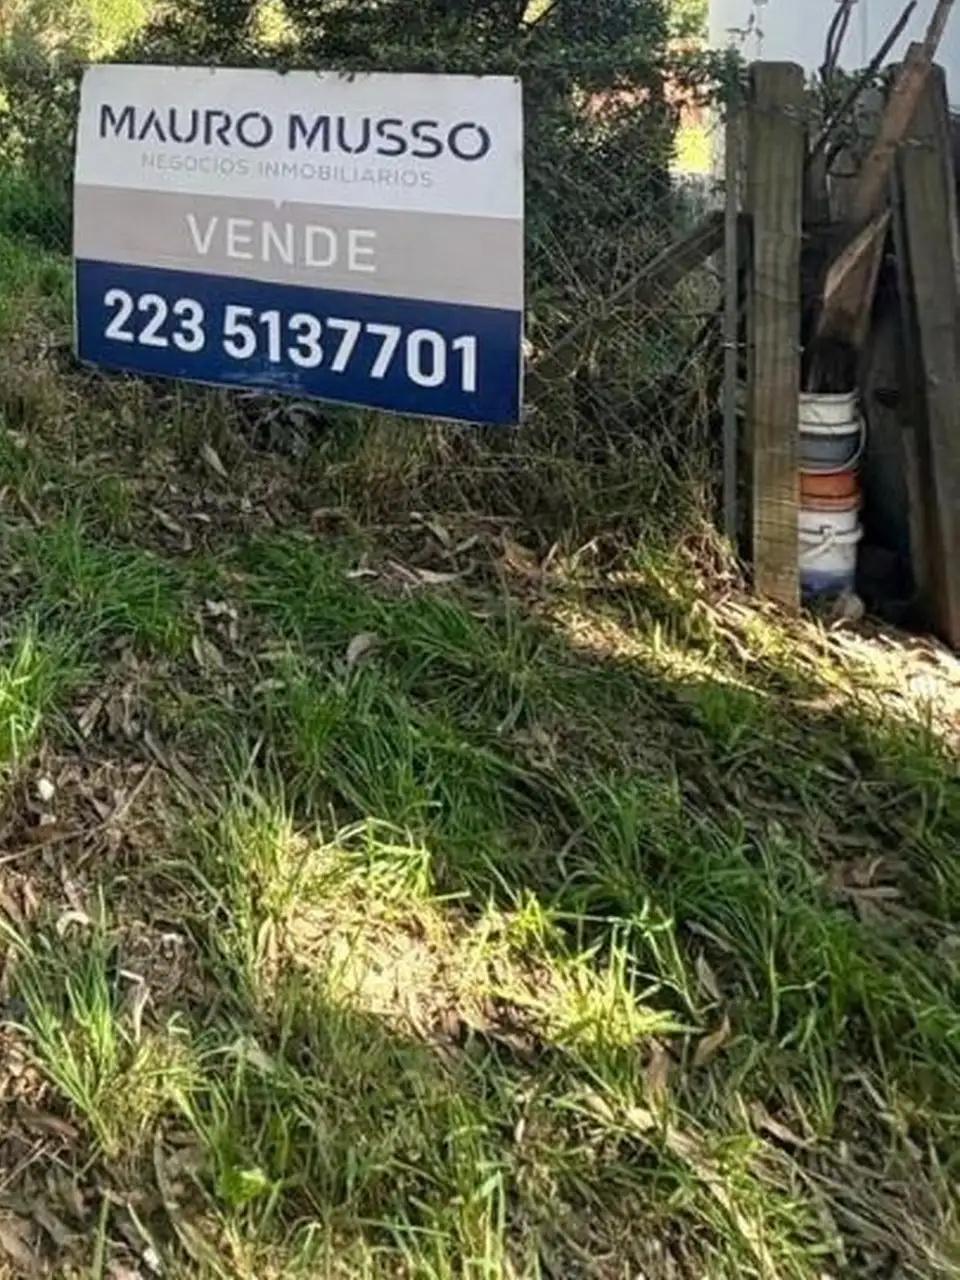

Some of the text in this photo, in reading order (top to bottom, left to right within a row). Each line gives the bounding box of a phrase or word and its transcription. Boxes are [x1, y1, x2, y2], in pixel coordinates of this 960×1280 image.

[99, 104, 491, 162] MAURO MUSSO
[141, 153, 434, 188] NEGOCIOS INMOBILIARIOS
[186, 213, 378, 273] VENDE
[103, 289, 478, 393] 223 5137701
